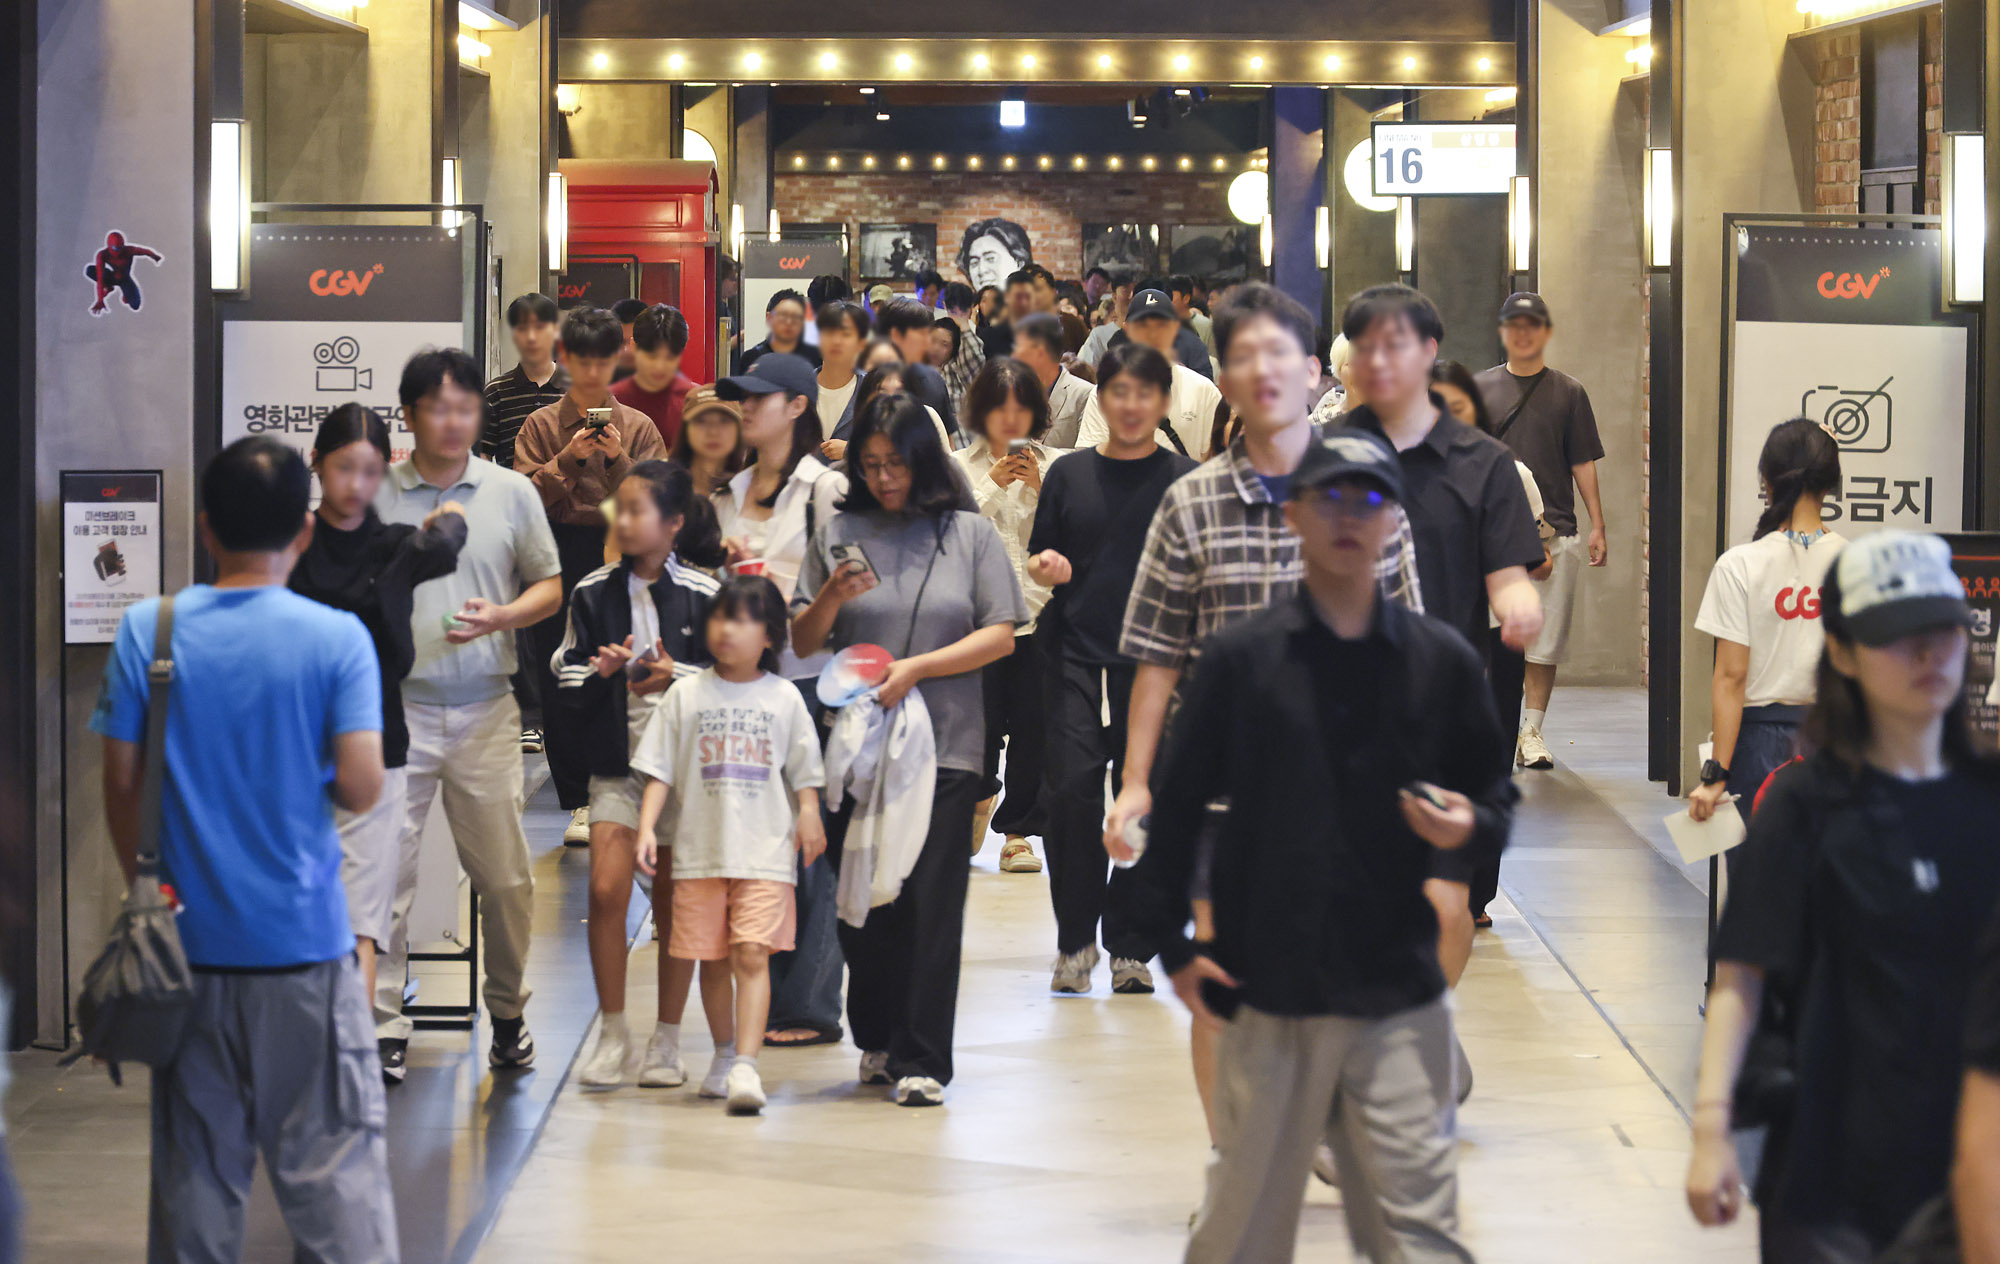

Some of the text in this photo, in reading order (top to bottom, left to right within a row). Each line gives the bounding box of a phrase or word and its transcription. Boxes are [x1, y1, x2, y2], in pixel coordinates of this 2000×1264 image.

[1380, 147, 1423, 184] 16
[779, 257, 806, 270] CGV
[309, 268, 375, 296] CGV
[558, 284, 586, 298] CGV
[1816, 271, 1881, 299] CGV
[73, 525, 148, 536] 이용 고객 입장 안내
[1775, 586, 1824, 621] CG
